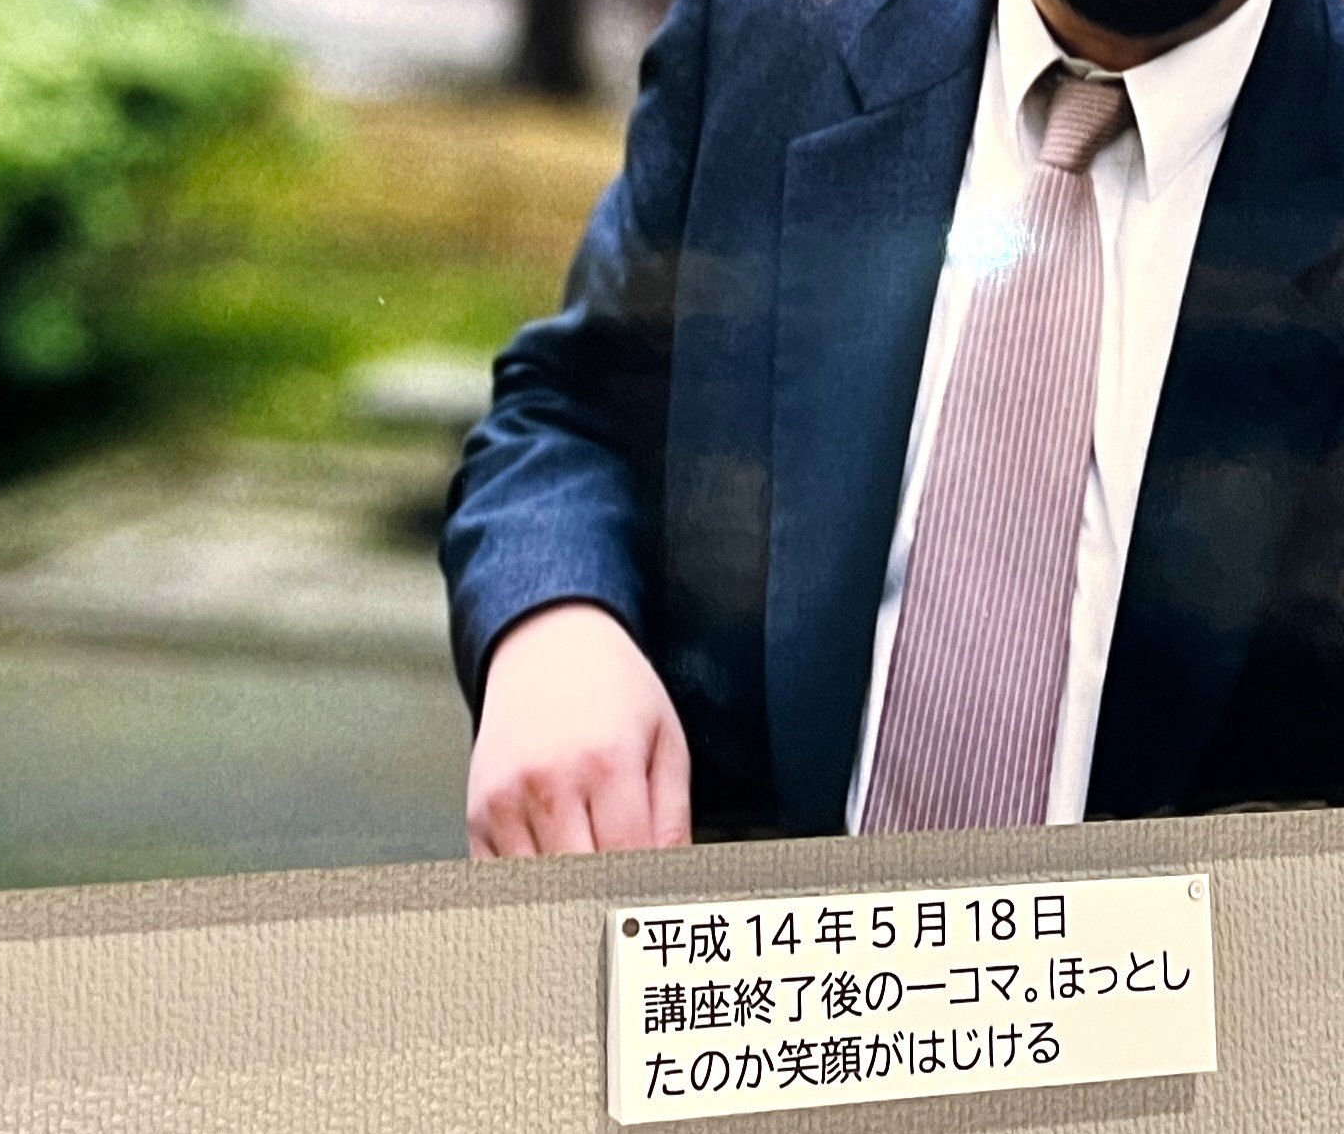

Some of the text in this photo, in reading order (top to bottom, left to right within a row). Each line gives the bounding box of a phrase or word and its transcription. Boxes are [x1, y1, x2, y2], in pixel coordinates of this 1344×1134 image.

[643, 950, 1191, 1035] 講座終了後の一コマ。ほっとし
[645, 1023, 1060, 1100] たのか笑顔がはじける
